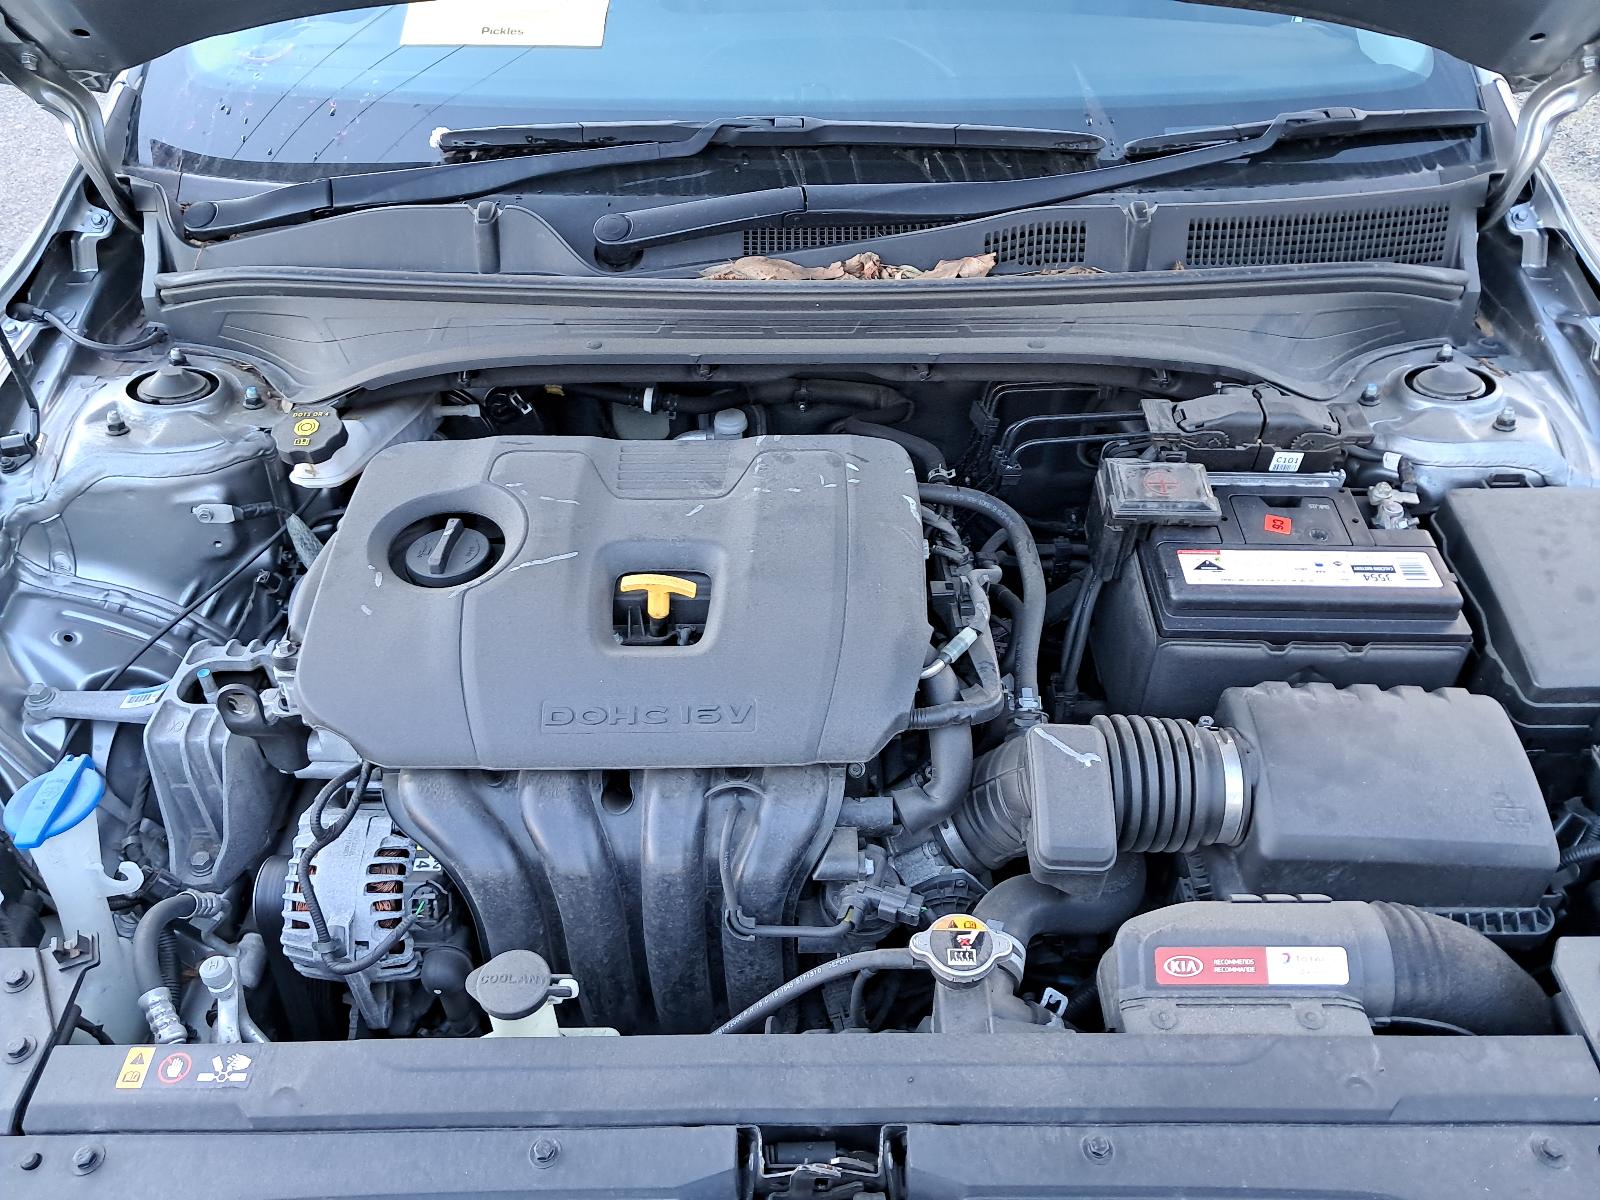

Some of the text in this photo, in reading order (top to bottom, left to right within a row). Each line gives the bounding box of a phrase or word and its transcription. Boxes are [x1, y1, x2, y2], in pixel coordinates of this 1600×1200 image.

[481, 26, 524, 35] Pickles
[544, 704, 752, 726] DOHC 16V
[208, 960, 219, 971] H
